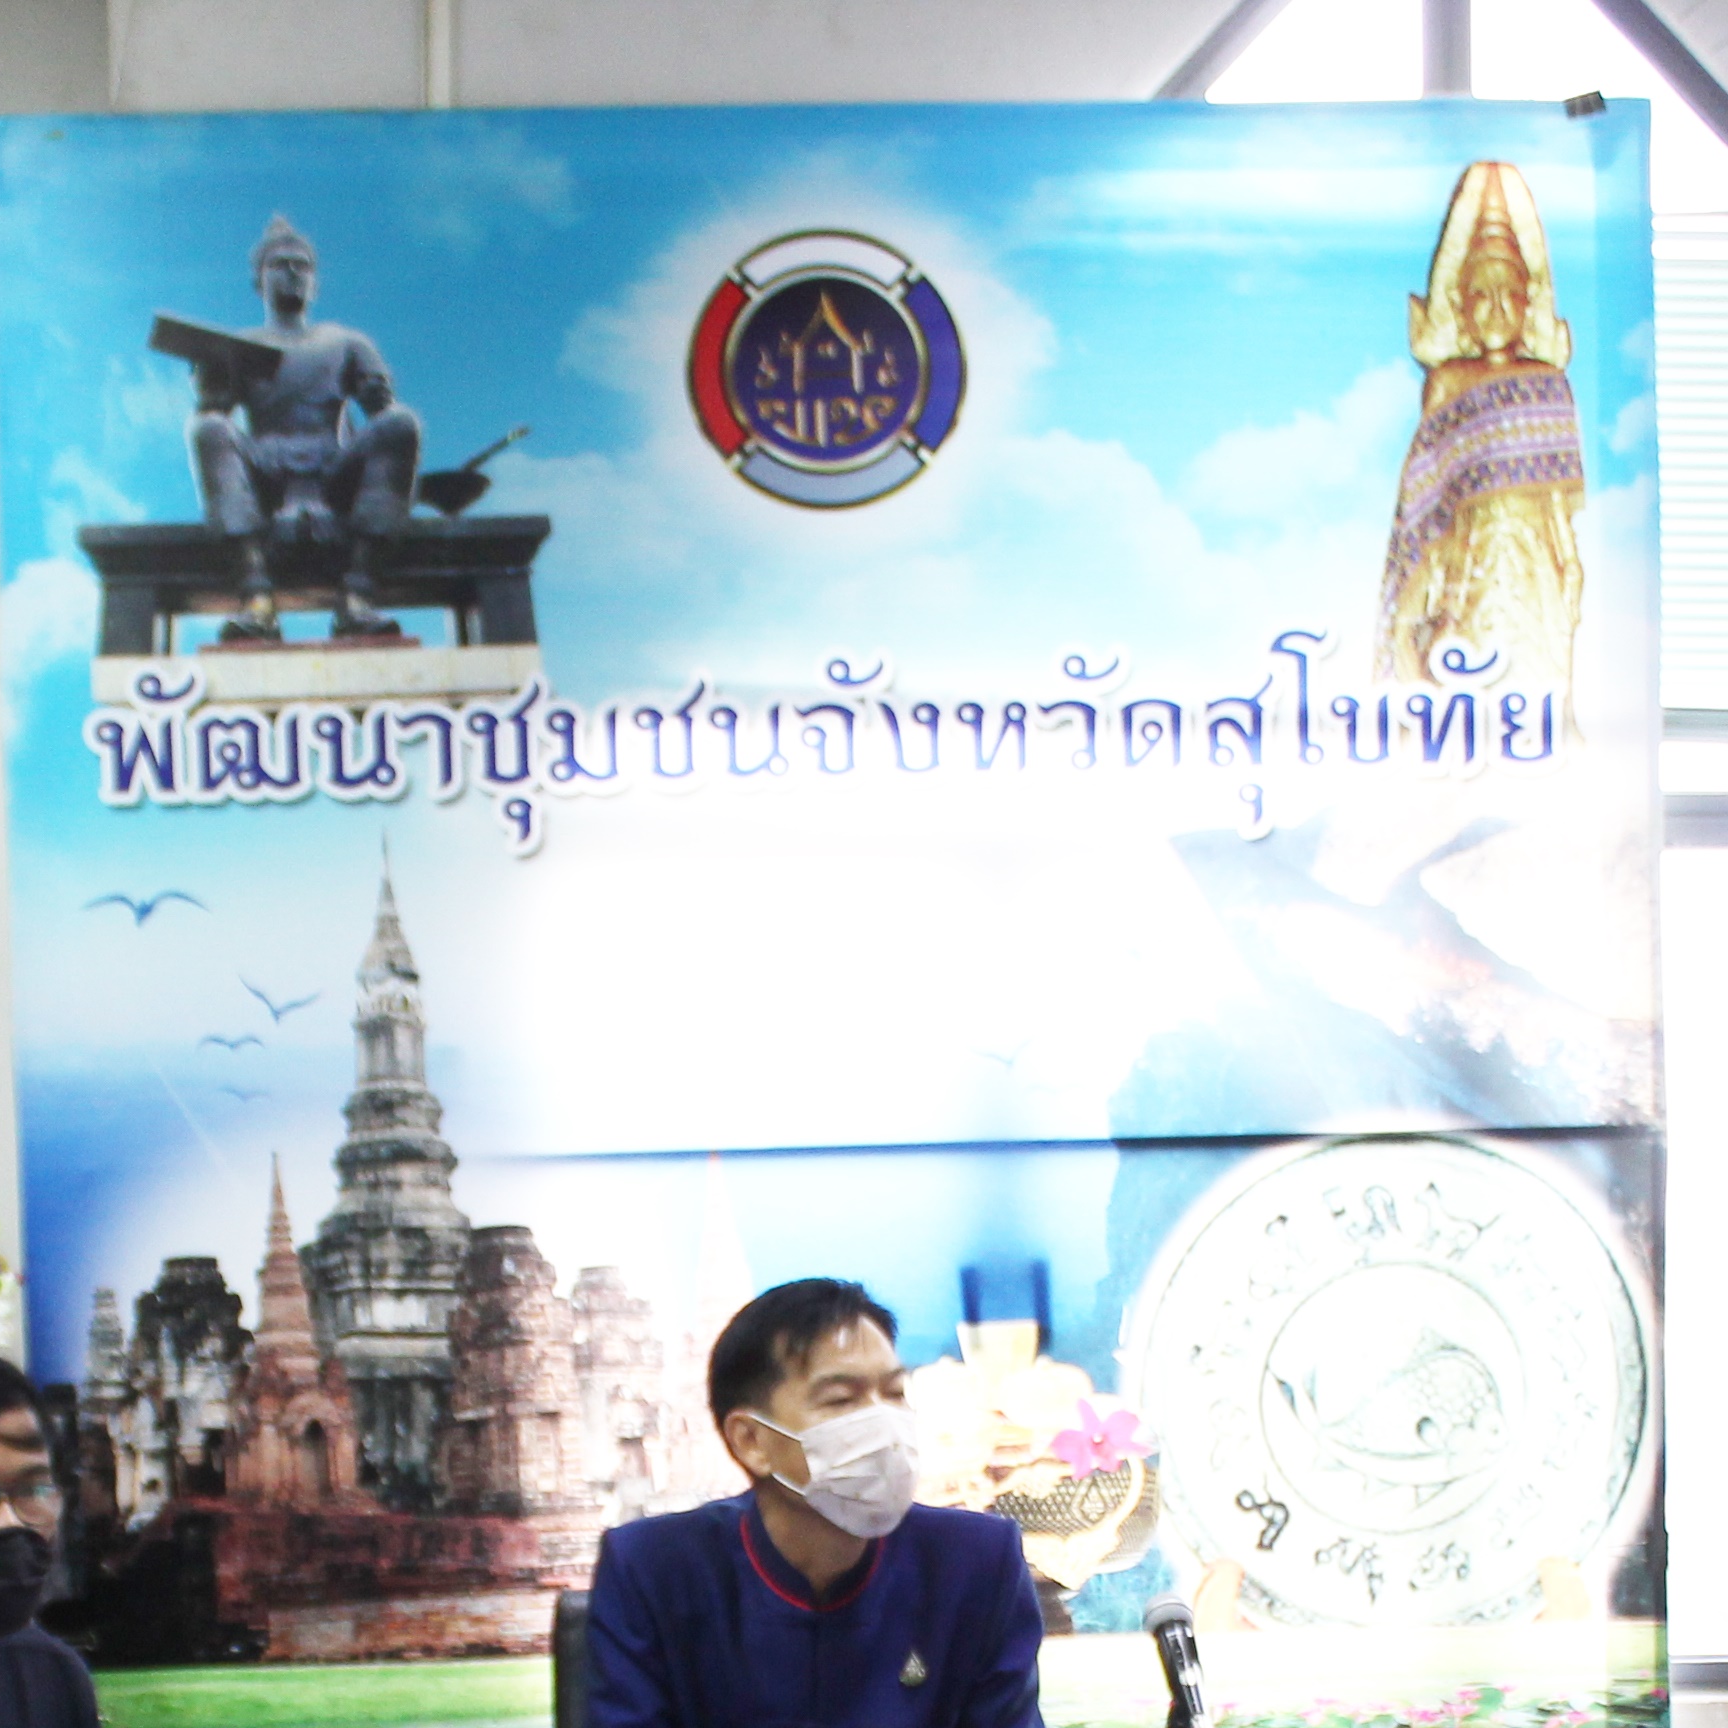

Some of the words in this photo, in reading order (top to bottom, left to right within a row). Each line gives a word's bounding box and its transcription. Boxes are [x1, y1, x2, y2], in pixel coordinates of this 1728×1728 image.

[96, 630, 1556, 842] พัฒนาชุมชนจังหวัดสุโขทัย
